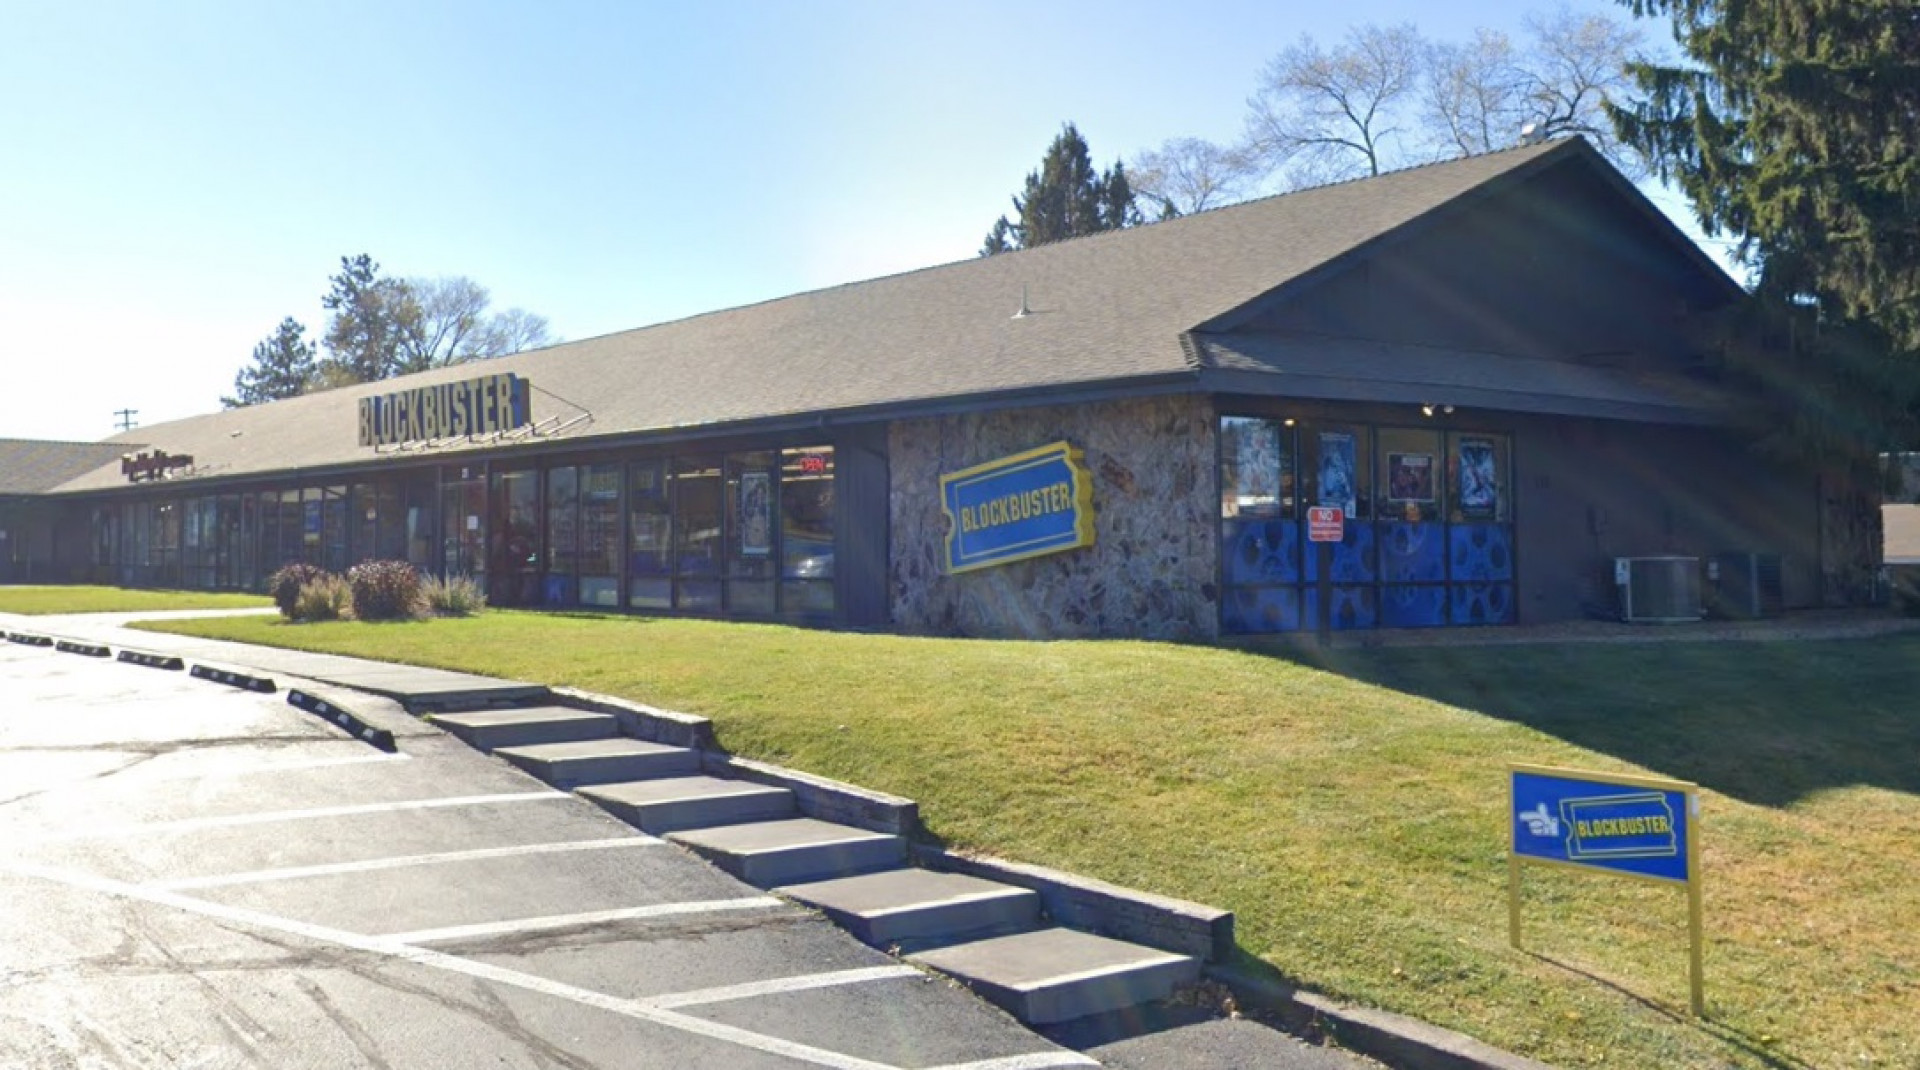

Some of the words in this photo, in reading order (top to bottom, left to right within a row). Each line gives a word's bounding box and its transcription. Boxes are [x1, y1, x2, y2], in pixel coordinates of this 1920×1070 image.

[359, 373, 515, 446] BLOCKBUSTER
[800, 457, 824, 472] OPEN
[960, 482, 1071, 532] BLOCKBUSTER
[1318, 510, 1334, 521] NO
[1576, 816, 1670, 838] BLOCKBUSTER
